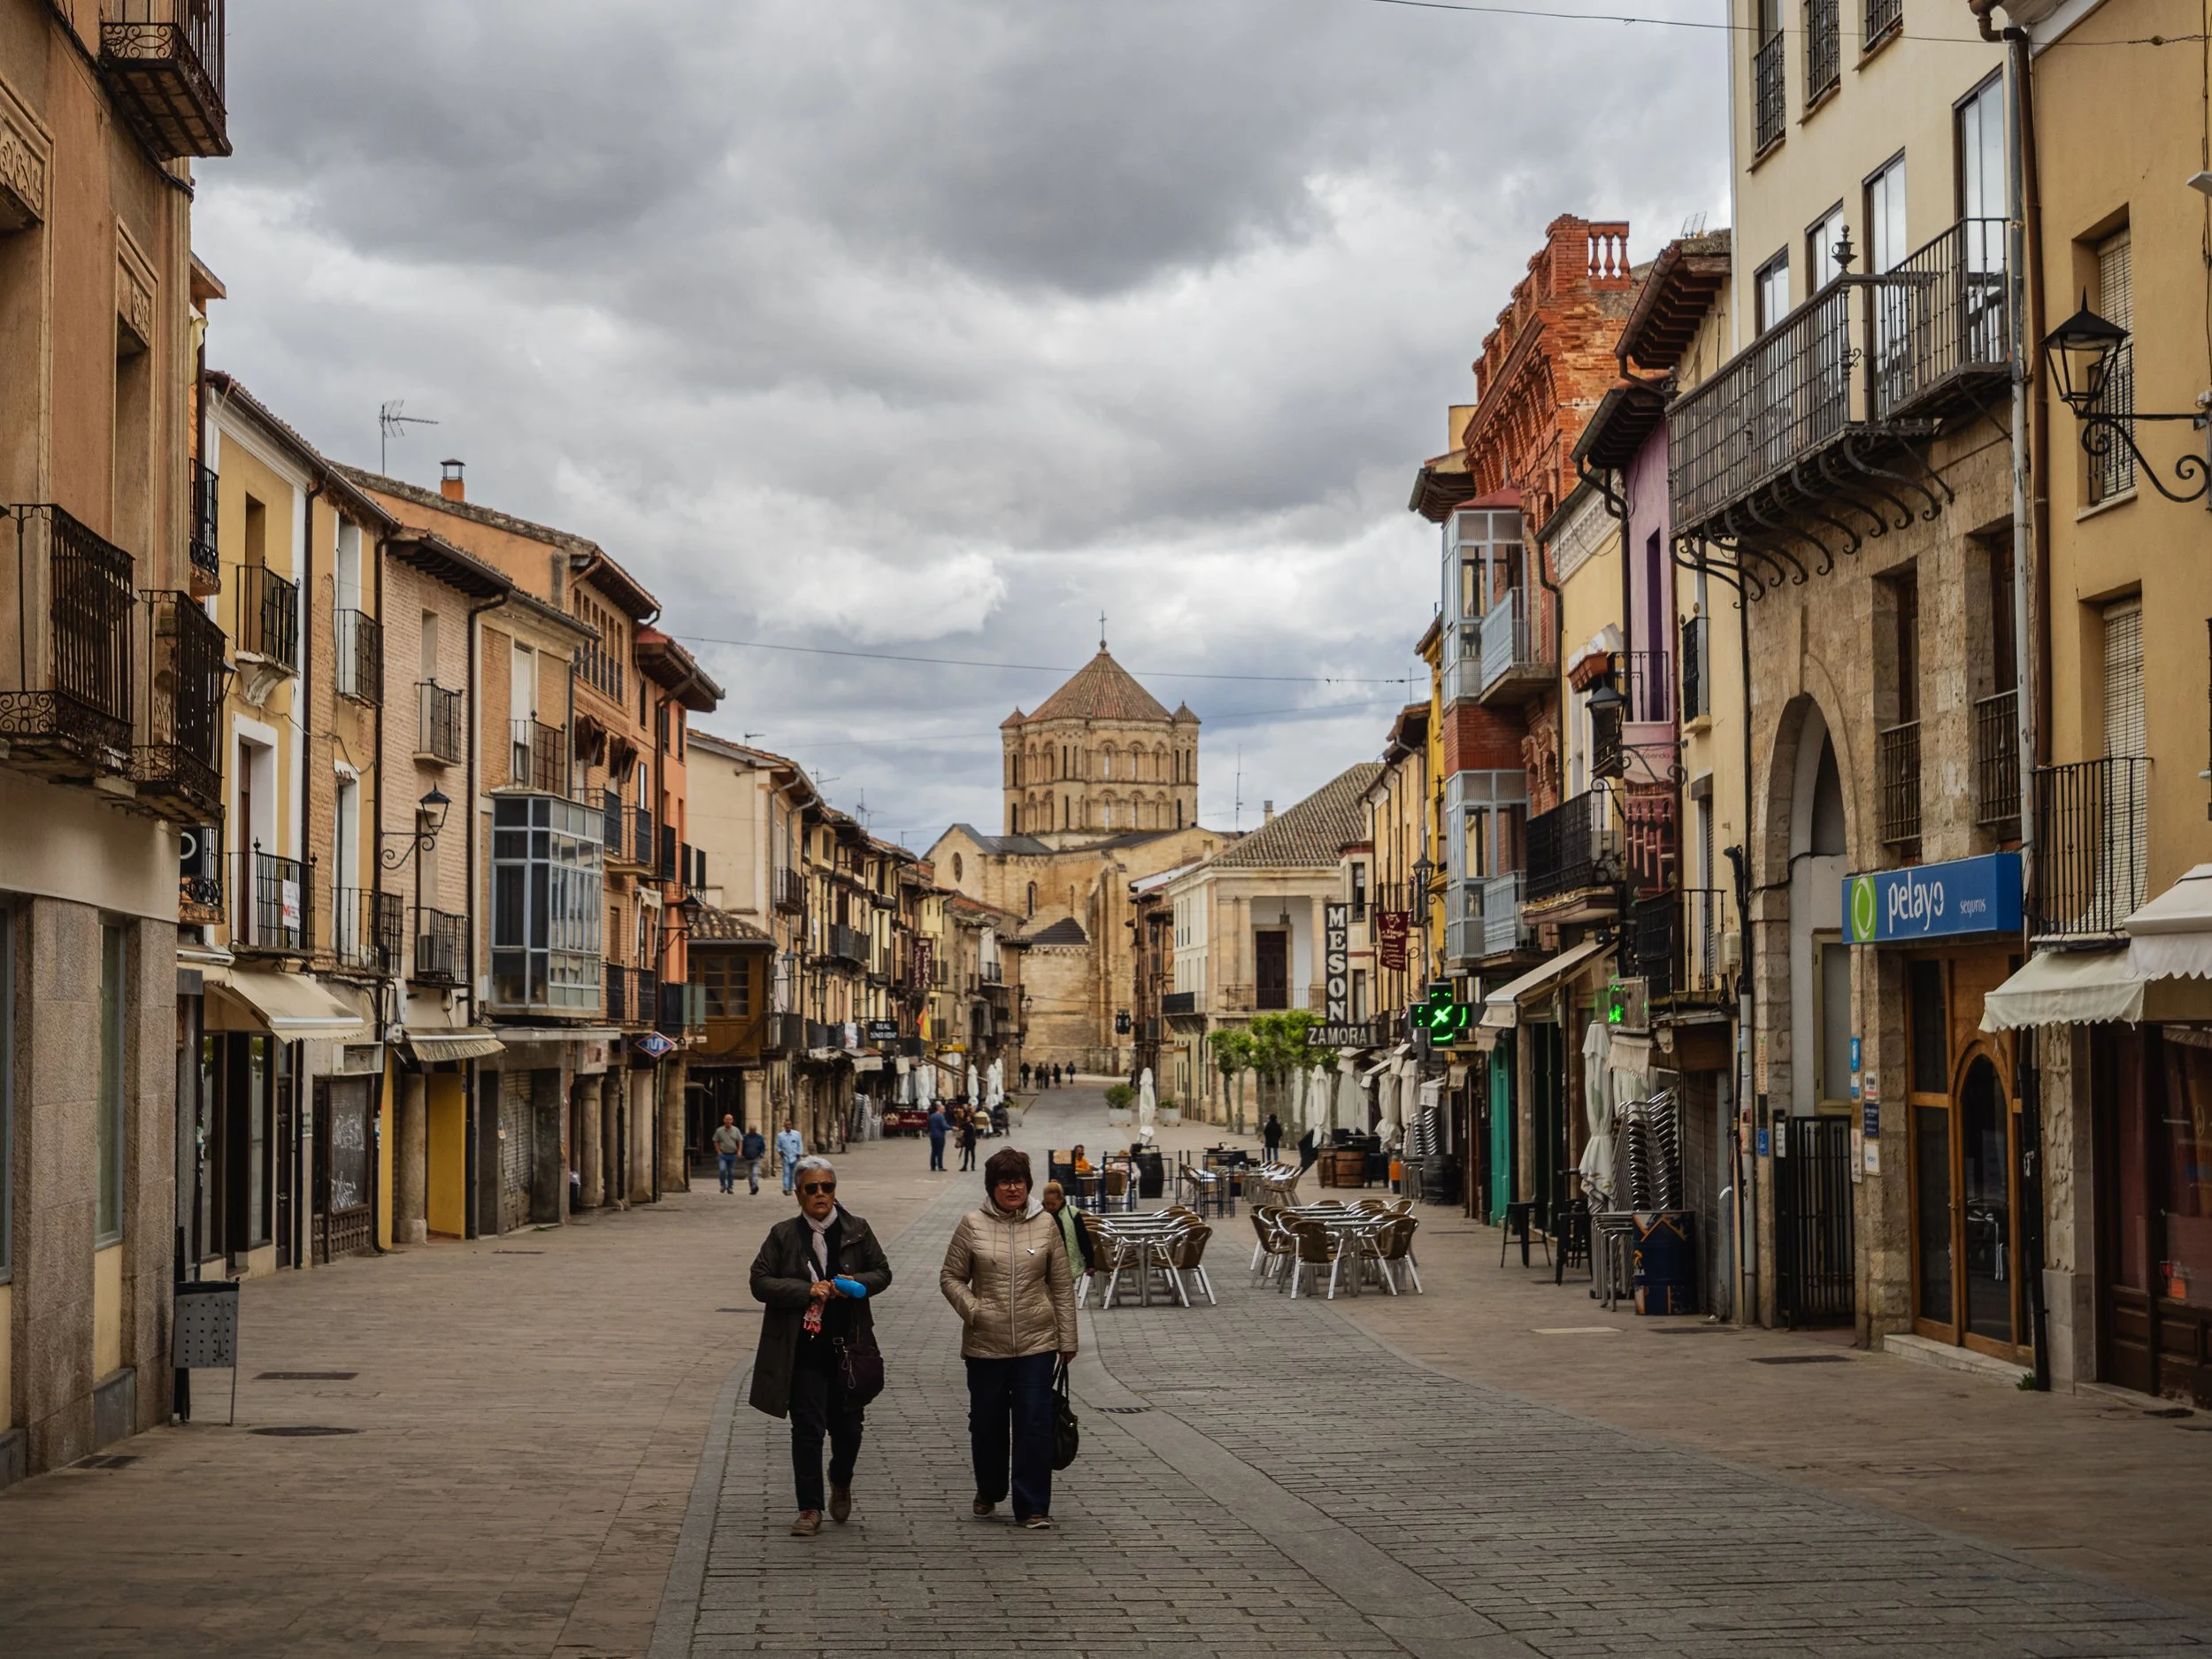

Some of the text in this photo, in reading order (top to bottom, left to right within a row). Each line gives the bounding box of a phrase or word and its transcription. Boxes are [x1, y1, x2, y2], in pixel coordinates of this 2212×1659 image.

[1888, 871, 1986, 934] pelayo seguros
[1327, 906, 1346, 1022] MESON
[1308, 1026, 1367, 1046] ZAMORA
